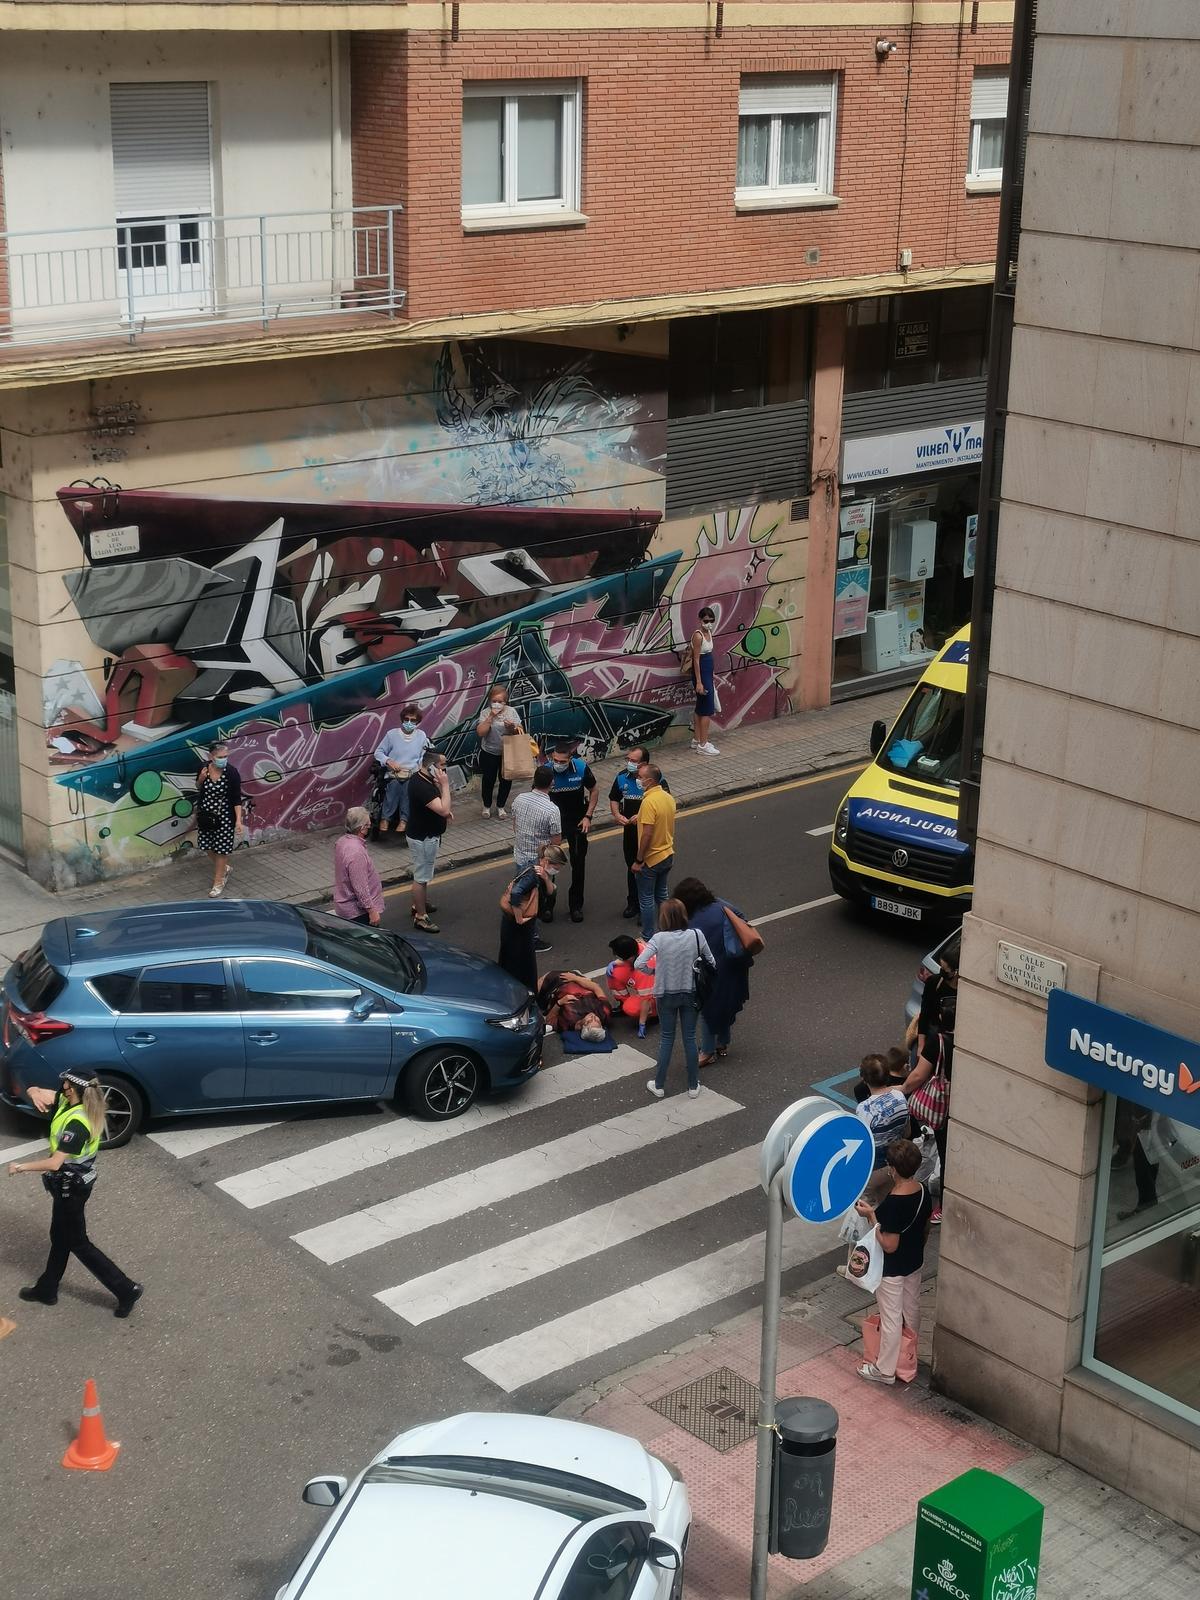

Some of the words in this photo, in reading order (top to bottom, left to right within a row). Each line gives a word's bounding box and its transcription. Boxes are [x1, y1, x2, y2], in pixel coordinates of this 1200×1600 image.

[916, 441, 949, 458] VILKEN
[846, 467, 889, 480] WWW.VILKEN.ES
[877, 899, 899, 915] 8893
[901, 905, 918, 919] JBK
[1019, 953, 1045, 969] CALLE
[1025, 962, 1036, 973] DE
[1002, 963, 1042, 983] CORTINAS
[1004, 972, 1020, 983] SAN
[1024, 979, 1051, 993] MIGUE
[1069, 1028, 1175, 1096] Naturgy
[921, 1507, 948, 1526] PROHIBIDO
[960, 1530, 982, 1547] CARTELES
[922, 1567, 971, 1600] CORREOS
